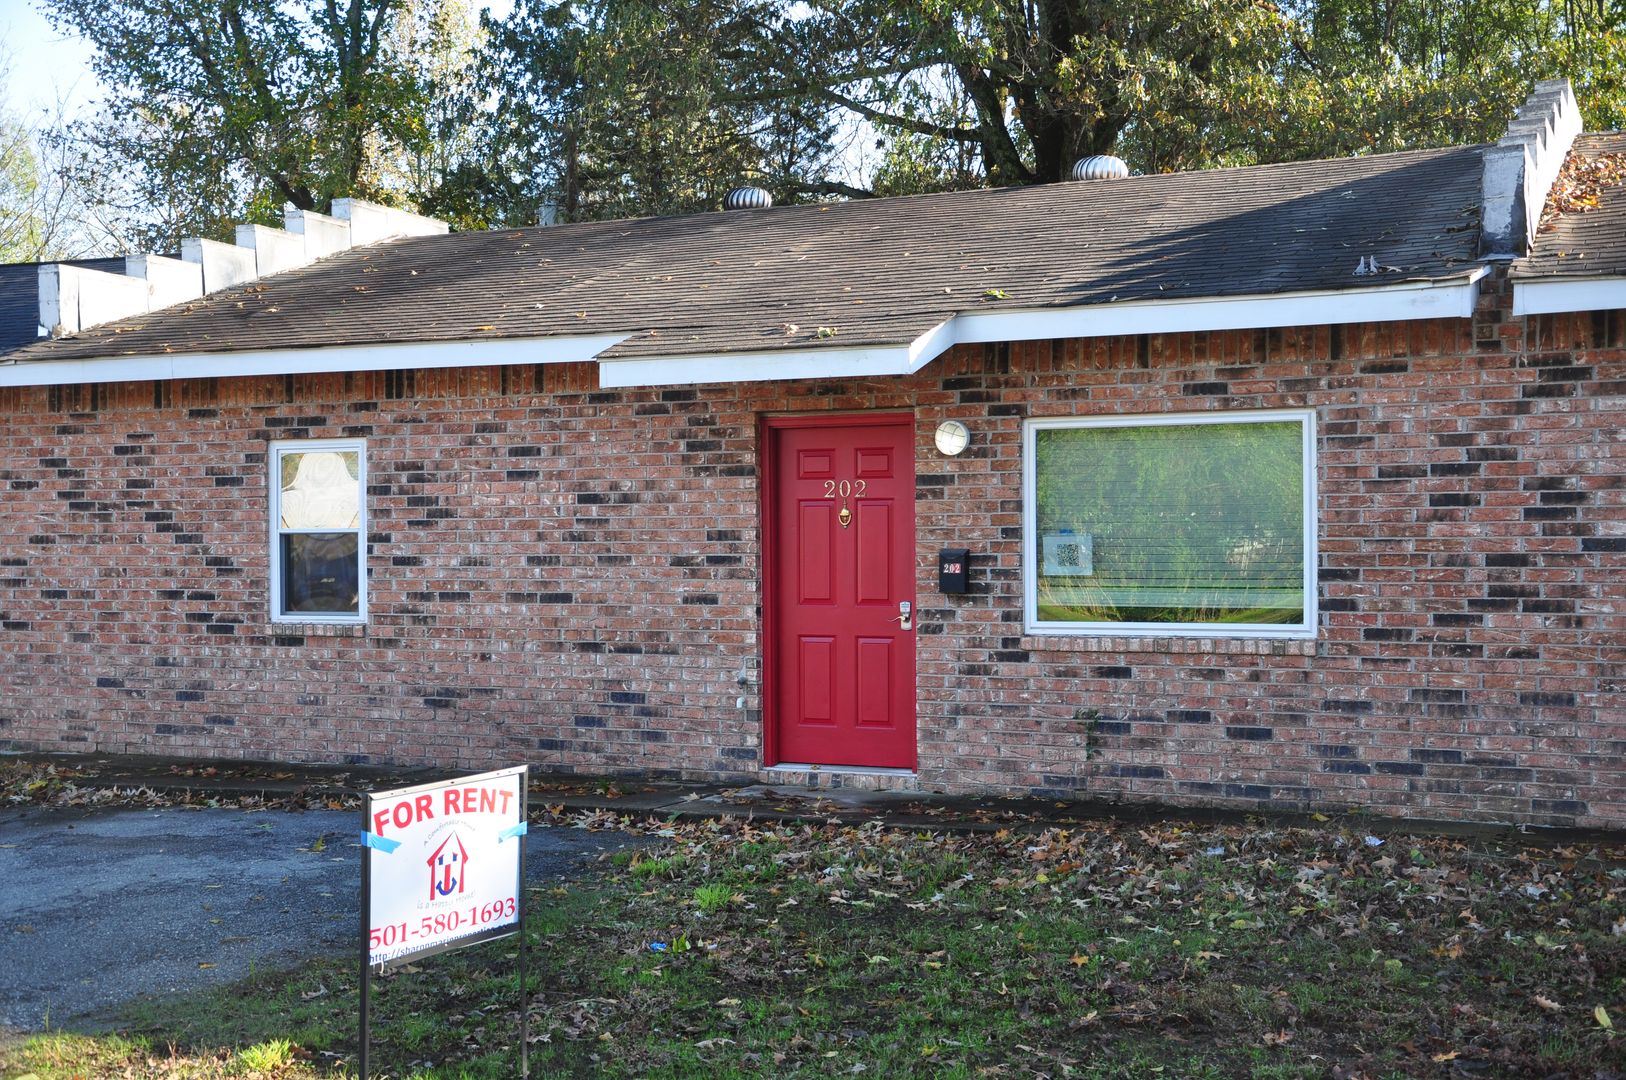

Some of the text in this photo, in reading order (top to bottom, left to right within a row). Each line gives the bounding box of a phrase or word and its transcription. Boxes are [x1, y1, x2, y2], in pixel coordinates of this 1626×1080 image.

[824, 479, 867, 498] 202
[943, 563, 961, 574] 202
[373, 787, 514, 837] FOR RENT
[368, 897, 516, 950] 501-580-1693
